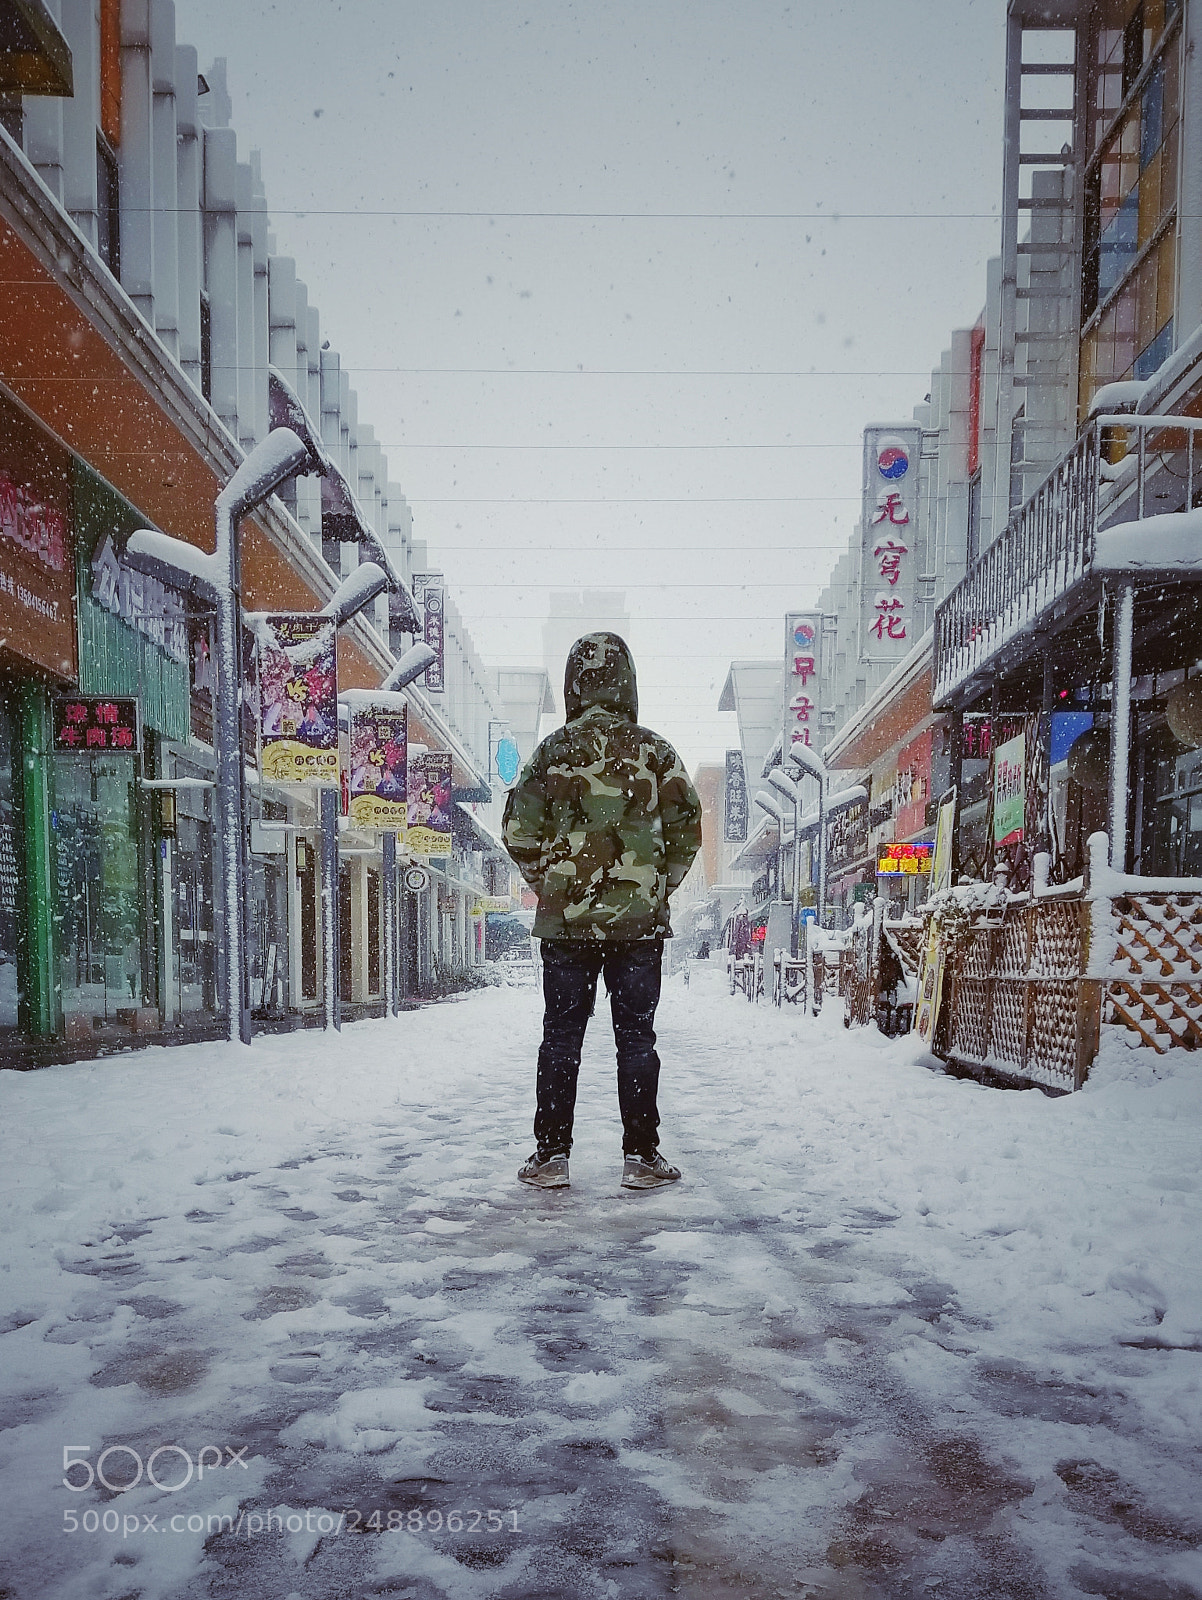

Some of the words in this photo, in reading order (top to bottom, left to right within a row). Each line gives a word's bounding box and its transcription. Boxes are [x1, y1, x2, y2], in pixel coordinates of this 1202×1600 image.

[286, 679, 308, 702] VS
[65, 703, 119, 724] 浓情
[60, 726, 133, 747] 牛肉汤
